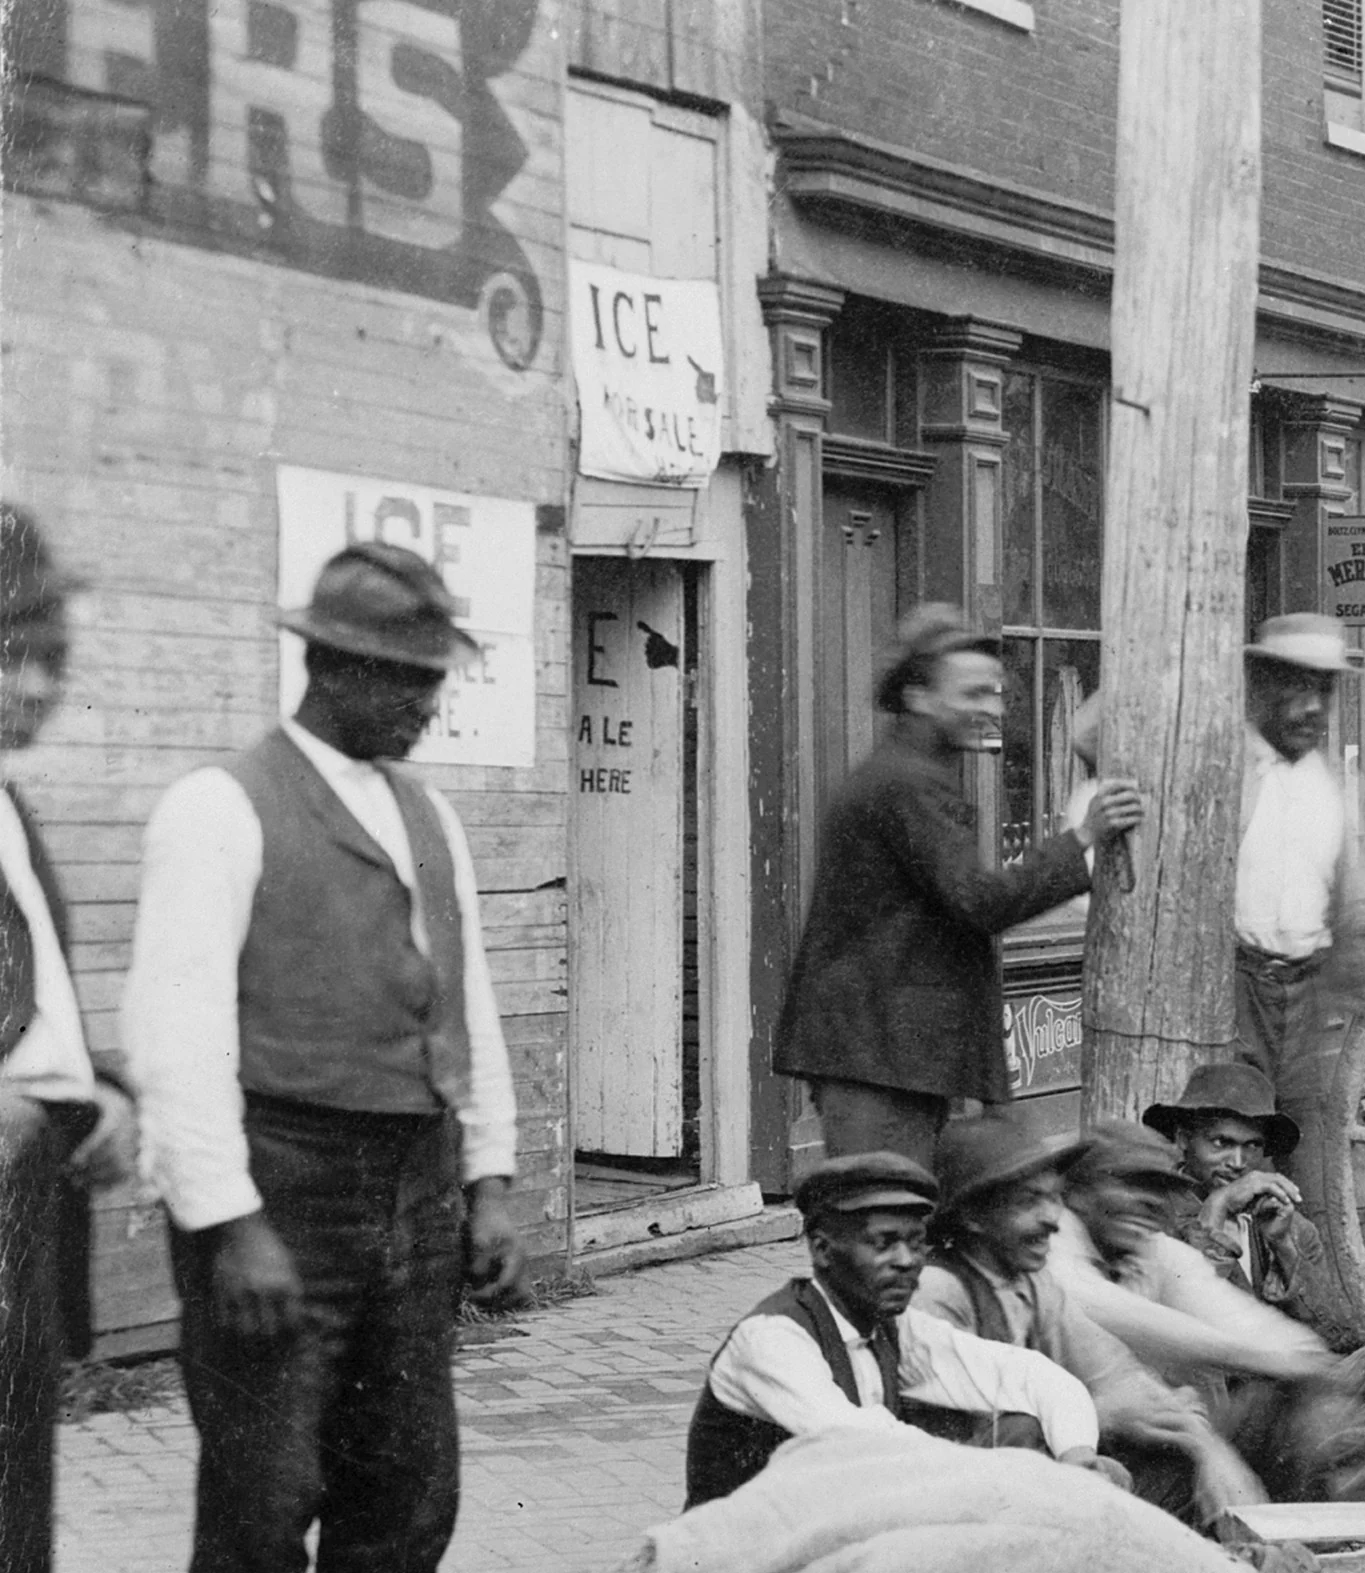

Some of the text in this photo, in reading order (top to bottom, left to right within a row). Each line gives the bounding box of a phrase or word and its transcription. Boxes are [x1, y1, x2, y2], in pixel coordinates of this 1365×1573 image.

[589, 283, 670, 364] ICE
[645, 408, 704, 456] SALE
[580, 768, 632, 794] HERE
